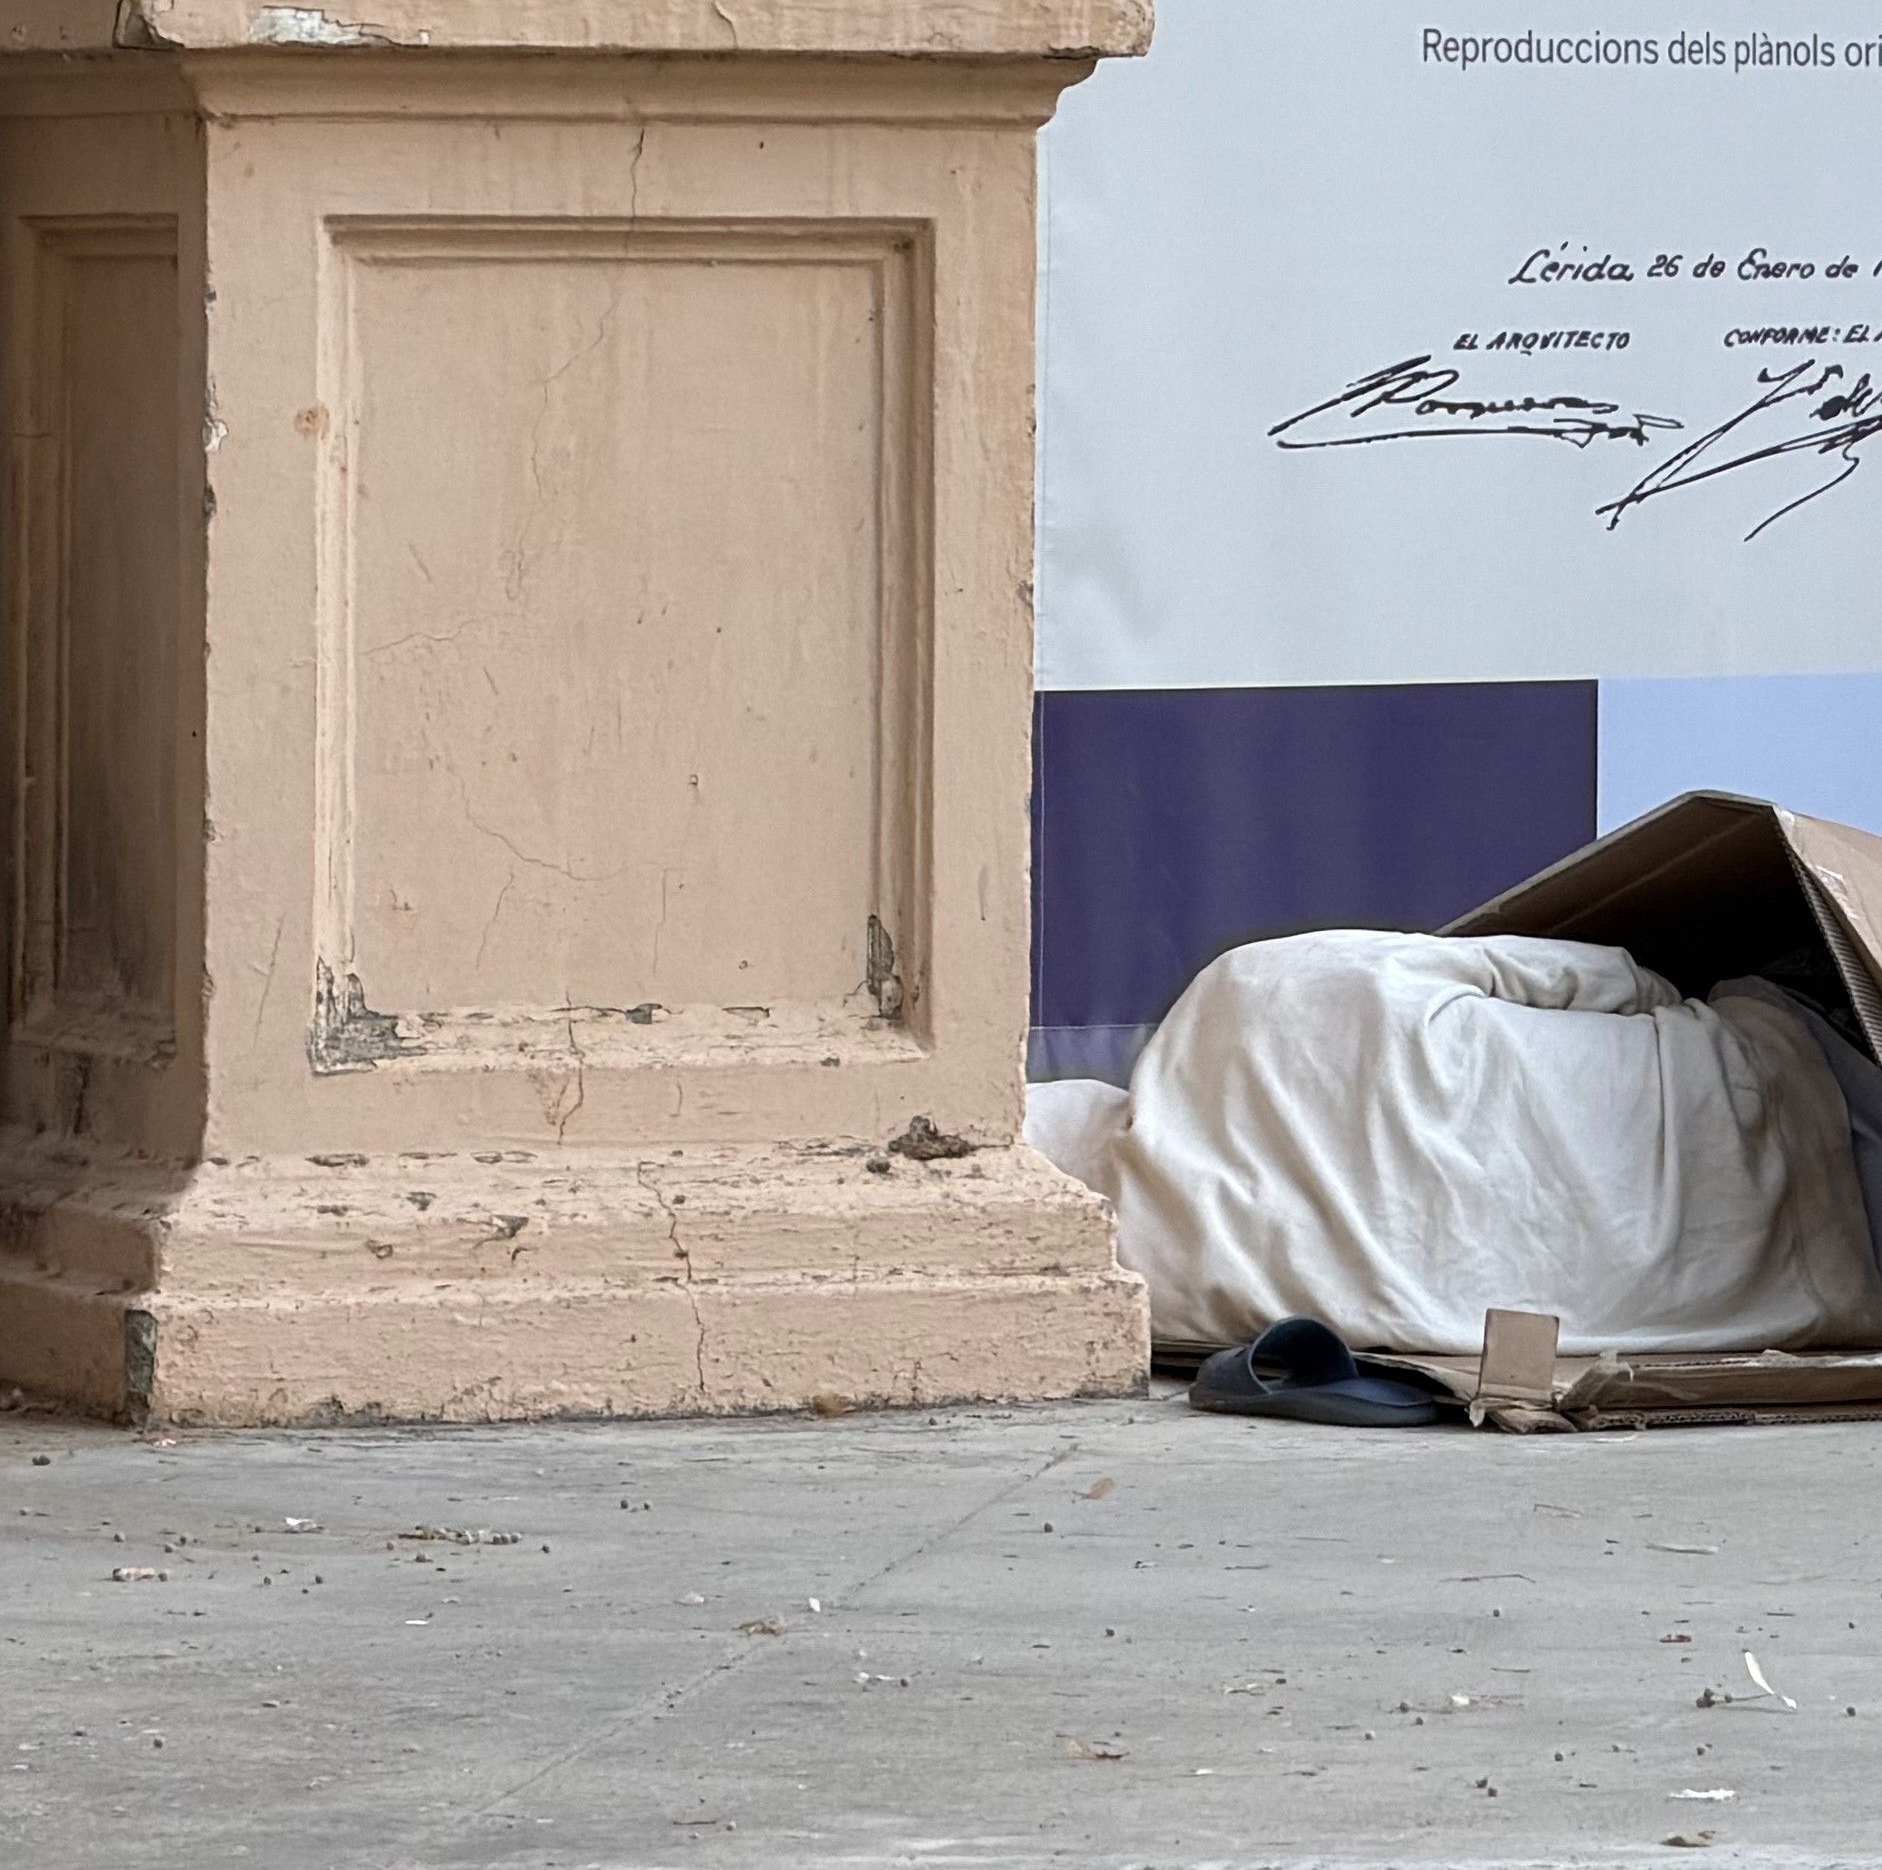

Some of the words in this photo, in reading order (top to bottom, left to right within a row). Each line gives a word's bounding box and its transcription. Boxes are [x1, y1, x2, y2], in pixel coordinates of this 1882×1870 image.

[1422, 28, 1660, 72] Reproduccions
[1667, 30, 1727, 66] dels
[1734, 31, 1836, 74] plànols
[1646, 253, 1684, 278] 26
[1692, 252, 1726, 279] de
[1736, 247, 1816, 281] Enero
[1824, 254, 1860, 279] de
[1452, 333, 1479, 351] EL
[1723, 325, 1841, 348] CONFORME:
[1842, 323, 1870, 344] EL
